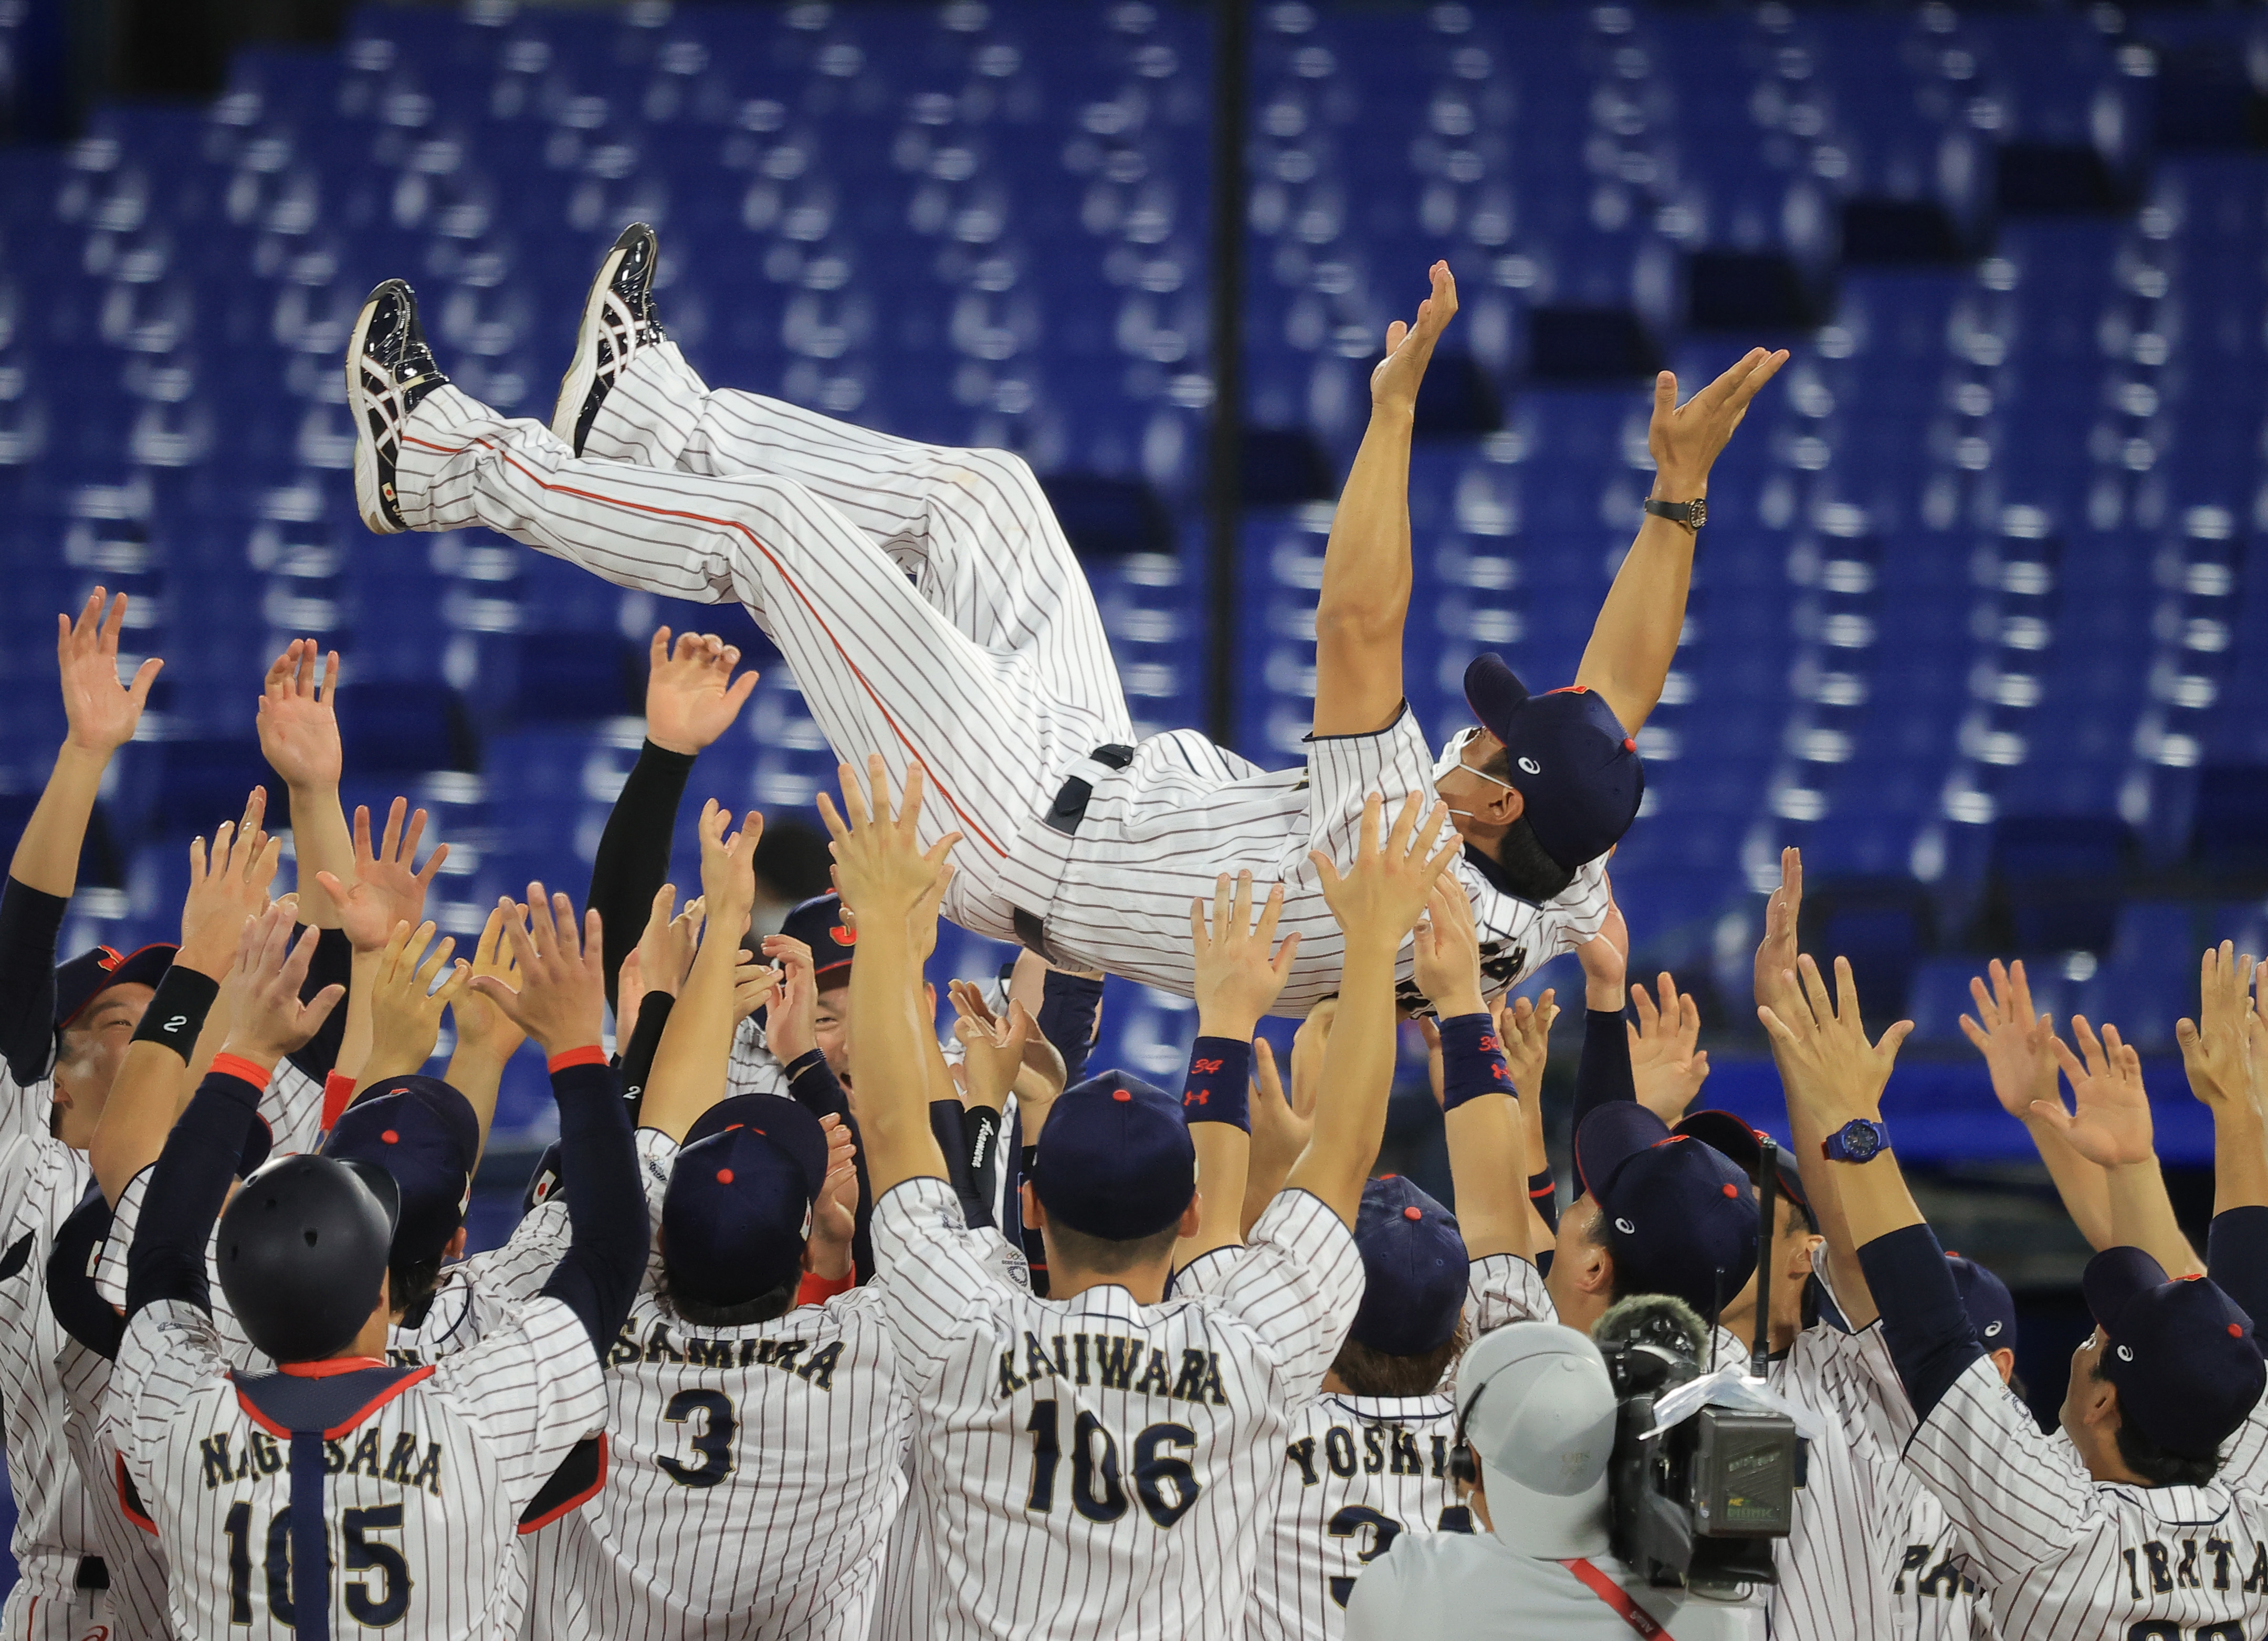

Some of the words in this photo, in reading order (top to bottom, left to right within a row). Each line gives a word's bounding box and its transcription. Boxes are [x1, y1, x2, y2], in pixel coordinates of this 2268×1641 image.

[163, 1016, 187, 1033] 2
[622, 1086, 640, 1100] 2
[1191, 1058, 1223, 1074] 34
[602, 1317, 846, 1392] SAMURA
[200, 1427, 442, 1497] NGSAKA
[657, 1388, 739, 1488] 3
[1026, 1399, 1202, 1530] 106
[223, 1500, 414, 1629] 105
[1328, 1505, 1476, 1611] 3
[2123, 1537, 2268, 1602] IBATA
